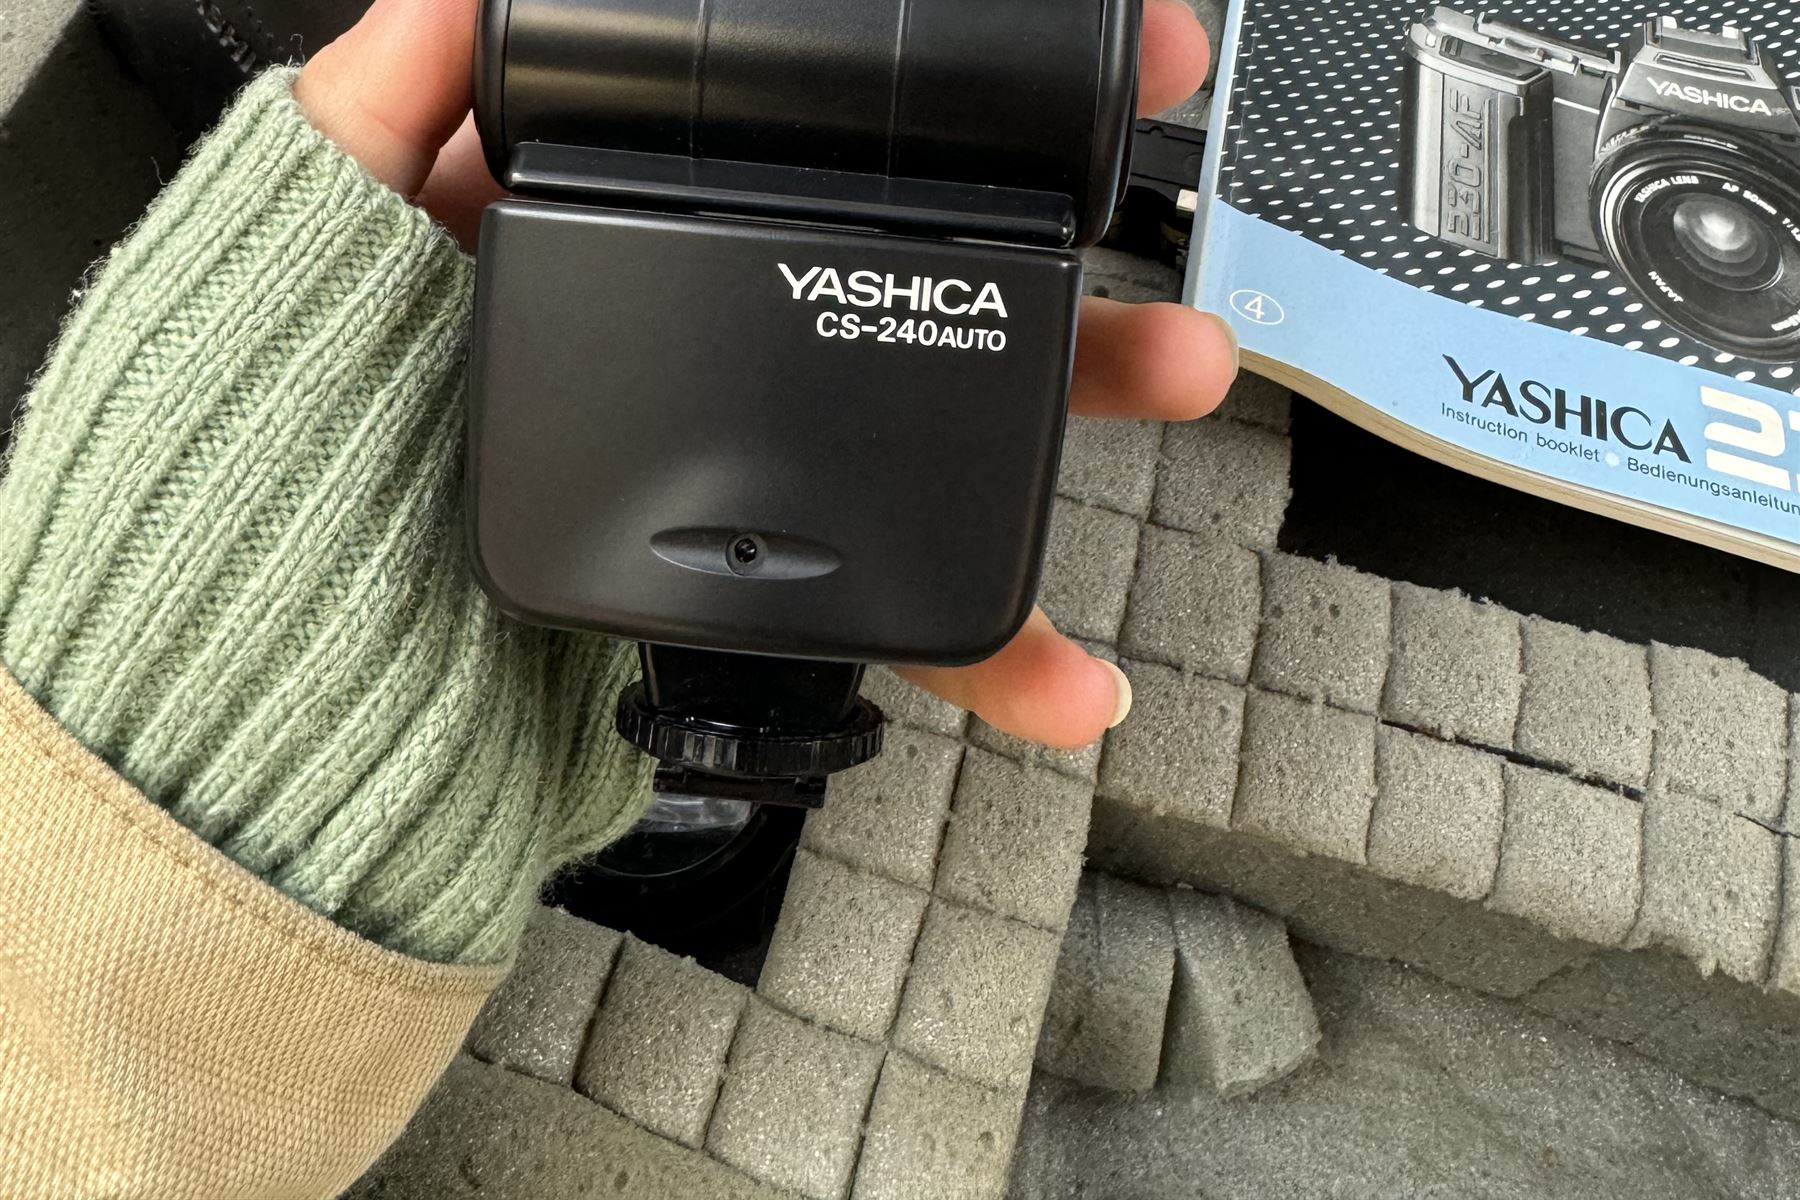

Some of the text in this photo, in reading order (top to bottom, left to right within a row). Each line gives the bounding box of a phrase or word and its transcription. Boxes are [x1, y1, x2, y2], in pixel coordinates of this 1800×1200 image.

[1647, 76, 1772, 116] YASHICA
[1634, 178, 1670, 203] YASHICA
[777, 263, 1008, 318] YASHICA
[1648, 270, 1684, 303] JAPAN
[1244, 295, 1265, 320] 4
[1441, 402, 1528, 443] Instruction
[1536, 432, 1600, 463] booklet
[1442, 354, 1800, 495] YASHICA 2
